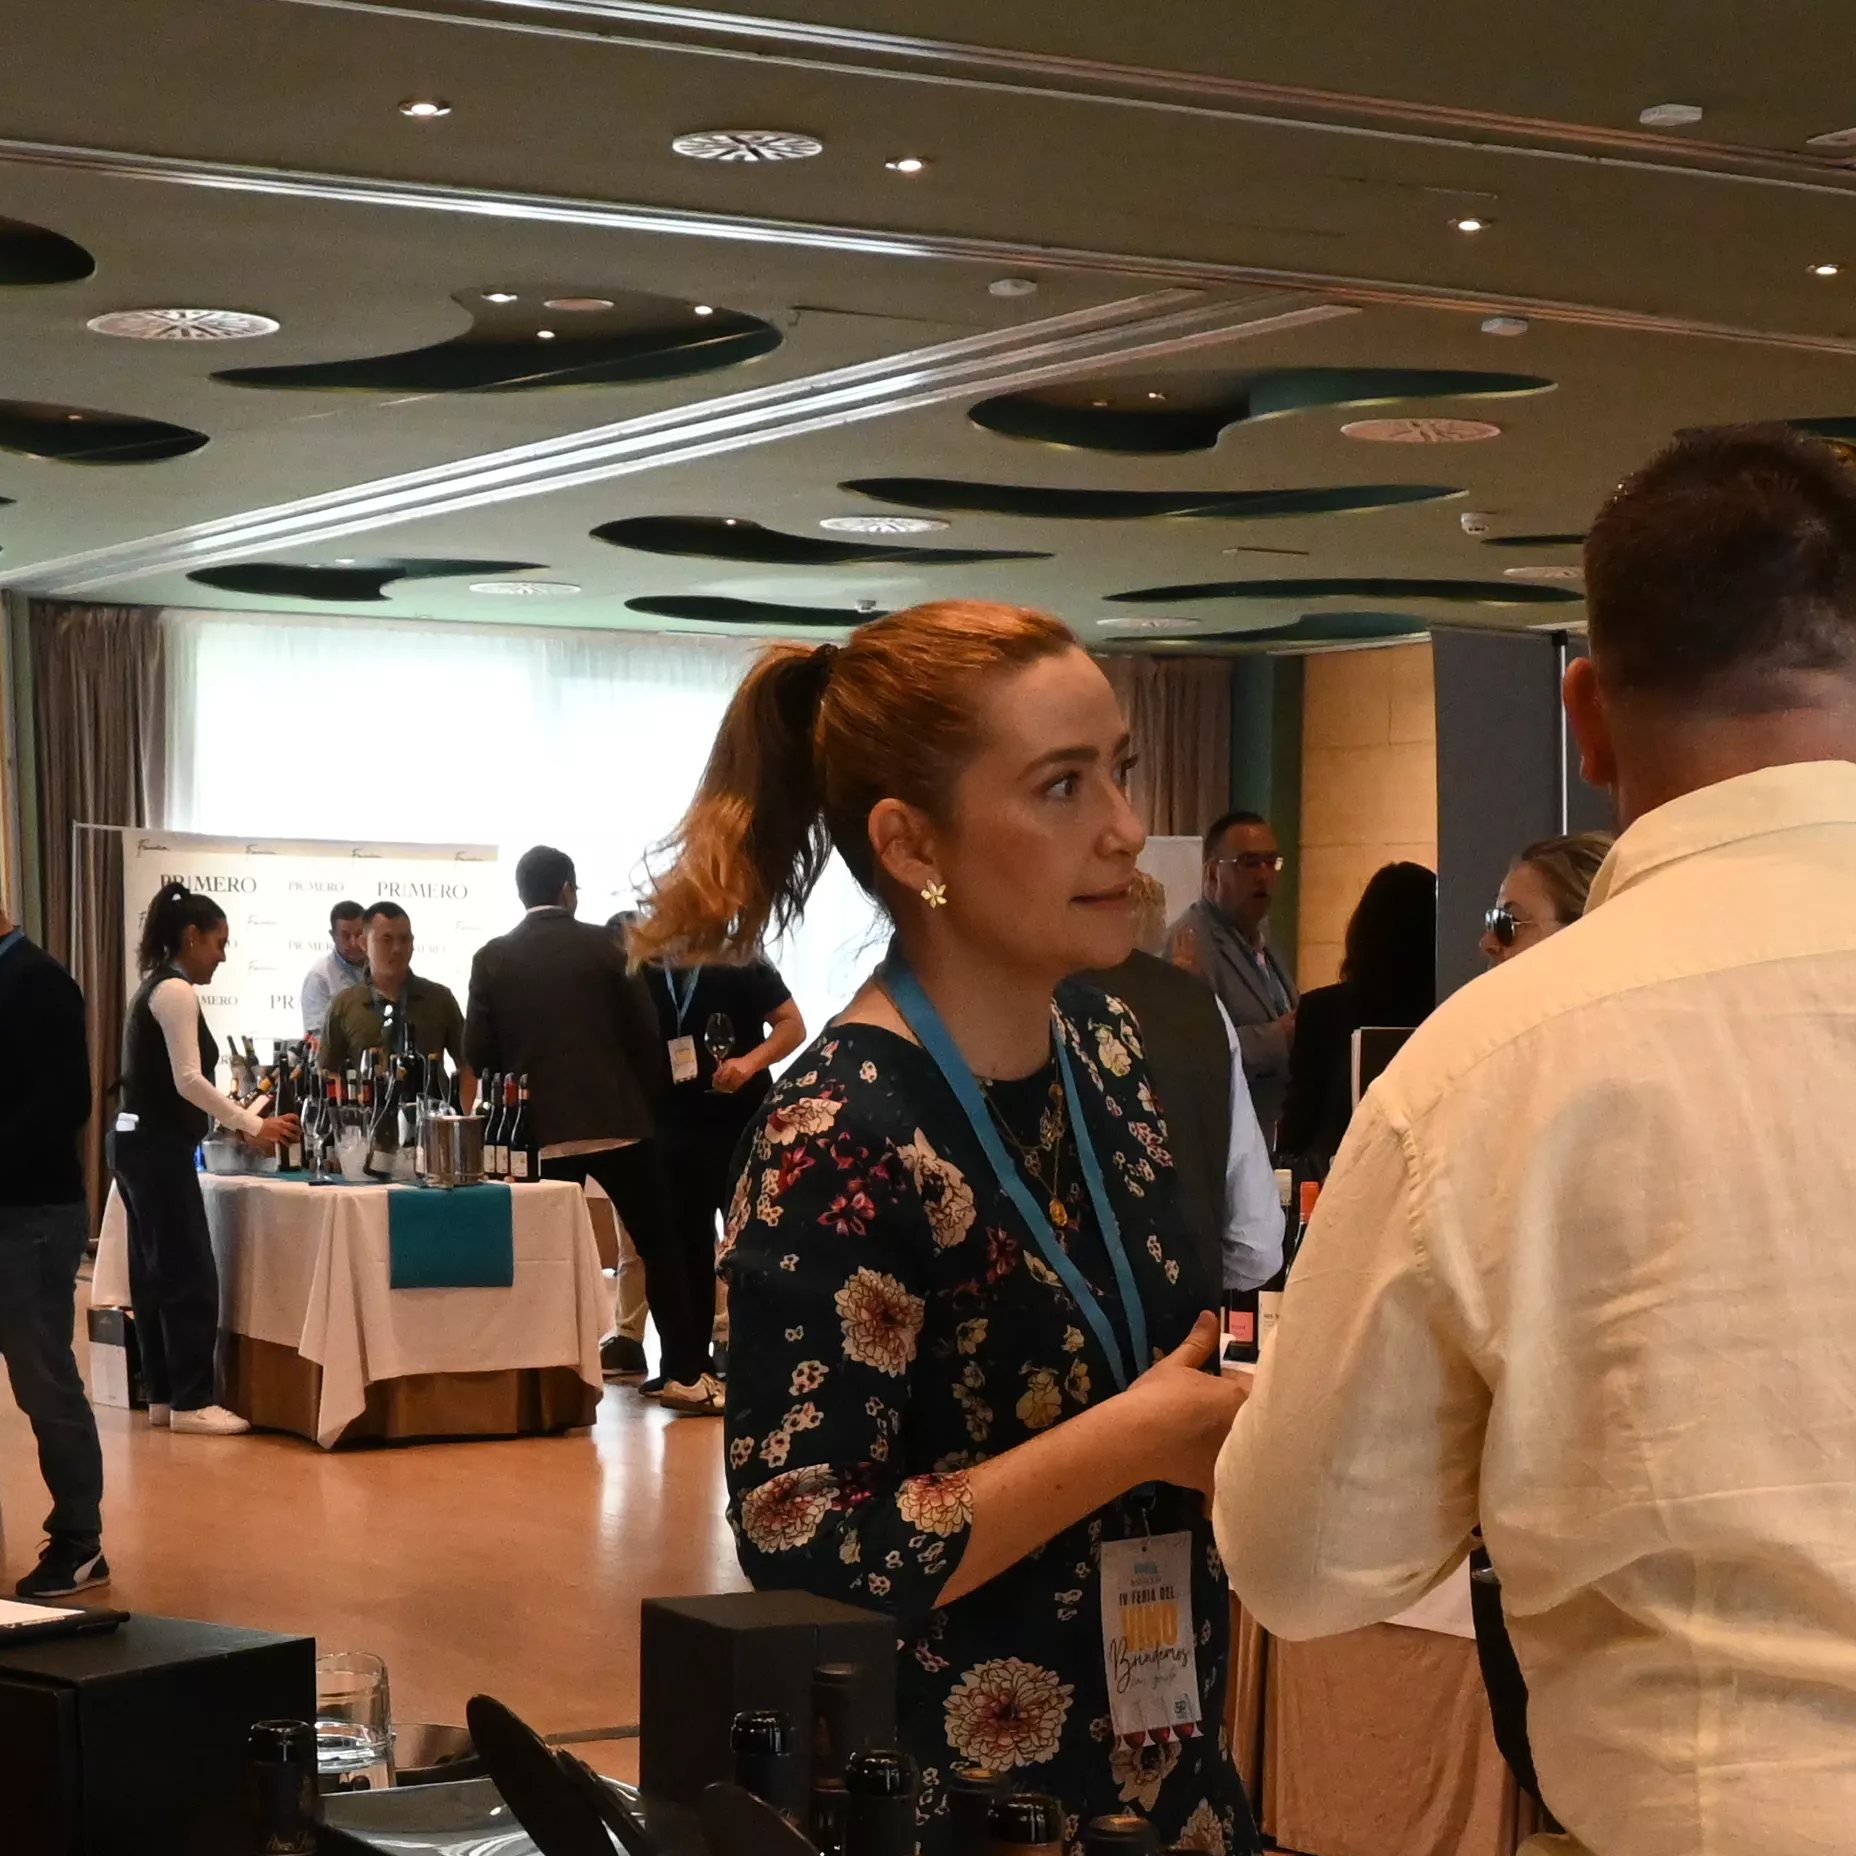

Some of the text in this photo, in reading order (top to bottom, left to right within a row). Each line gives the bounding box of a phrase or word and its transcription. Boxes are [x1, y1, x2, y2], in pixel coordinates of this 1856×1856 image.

[377, 881, 469, 900] PRIMERO
[1119, 1585, 1175, 1606] IV FERIA DEL
[1108, 1635, 1191, 1694] Brindemos
